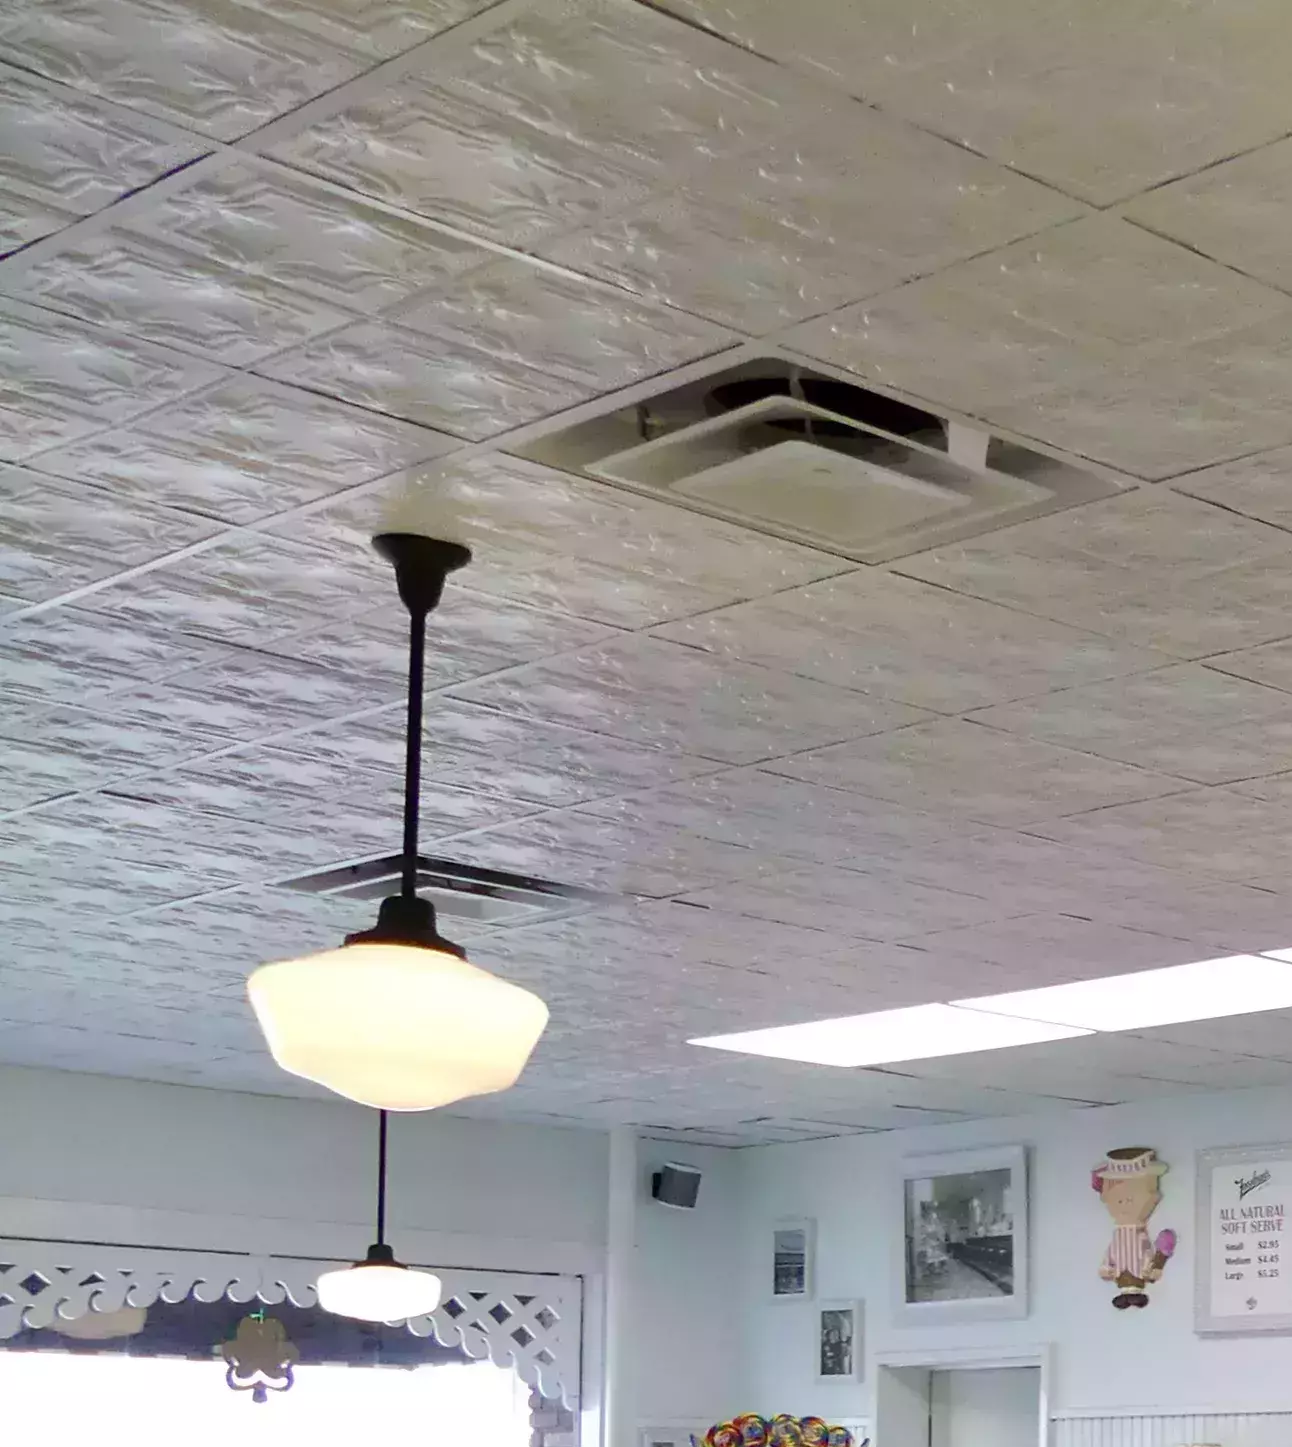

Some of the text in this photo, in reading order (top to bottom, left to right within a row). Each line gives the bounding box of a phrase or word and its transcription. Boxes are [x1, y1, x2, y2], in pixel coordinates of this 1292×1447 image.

[1219, 1204, 1285, 1221] ALL NATURAL
[1221, 1219, 1284, 1235] SOFT SERVE
